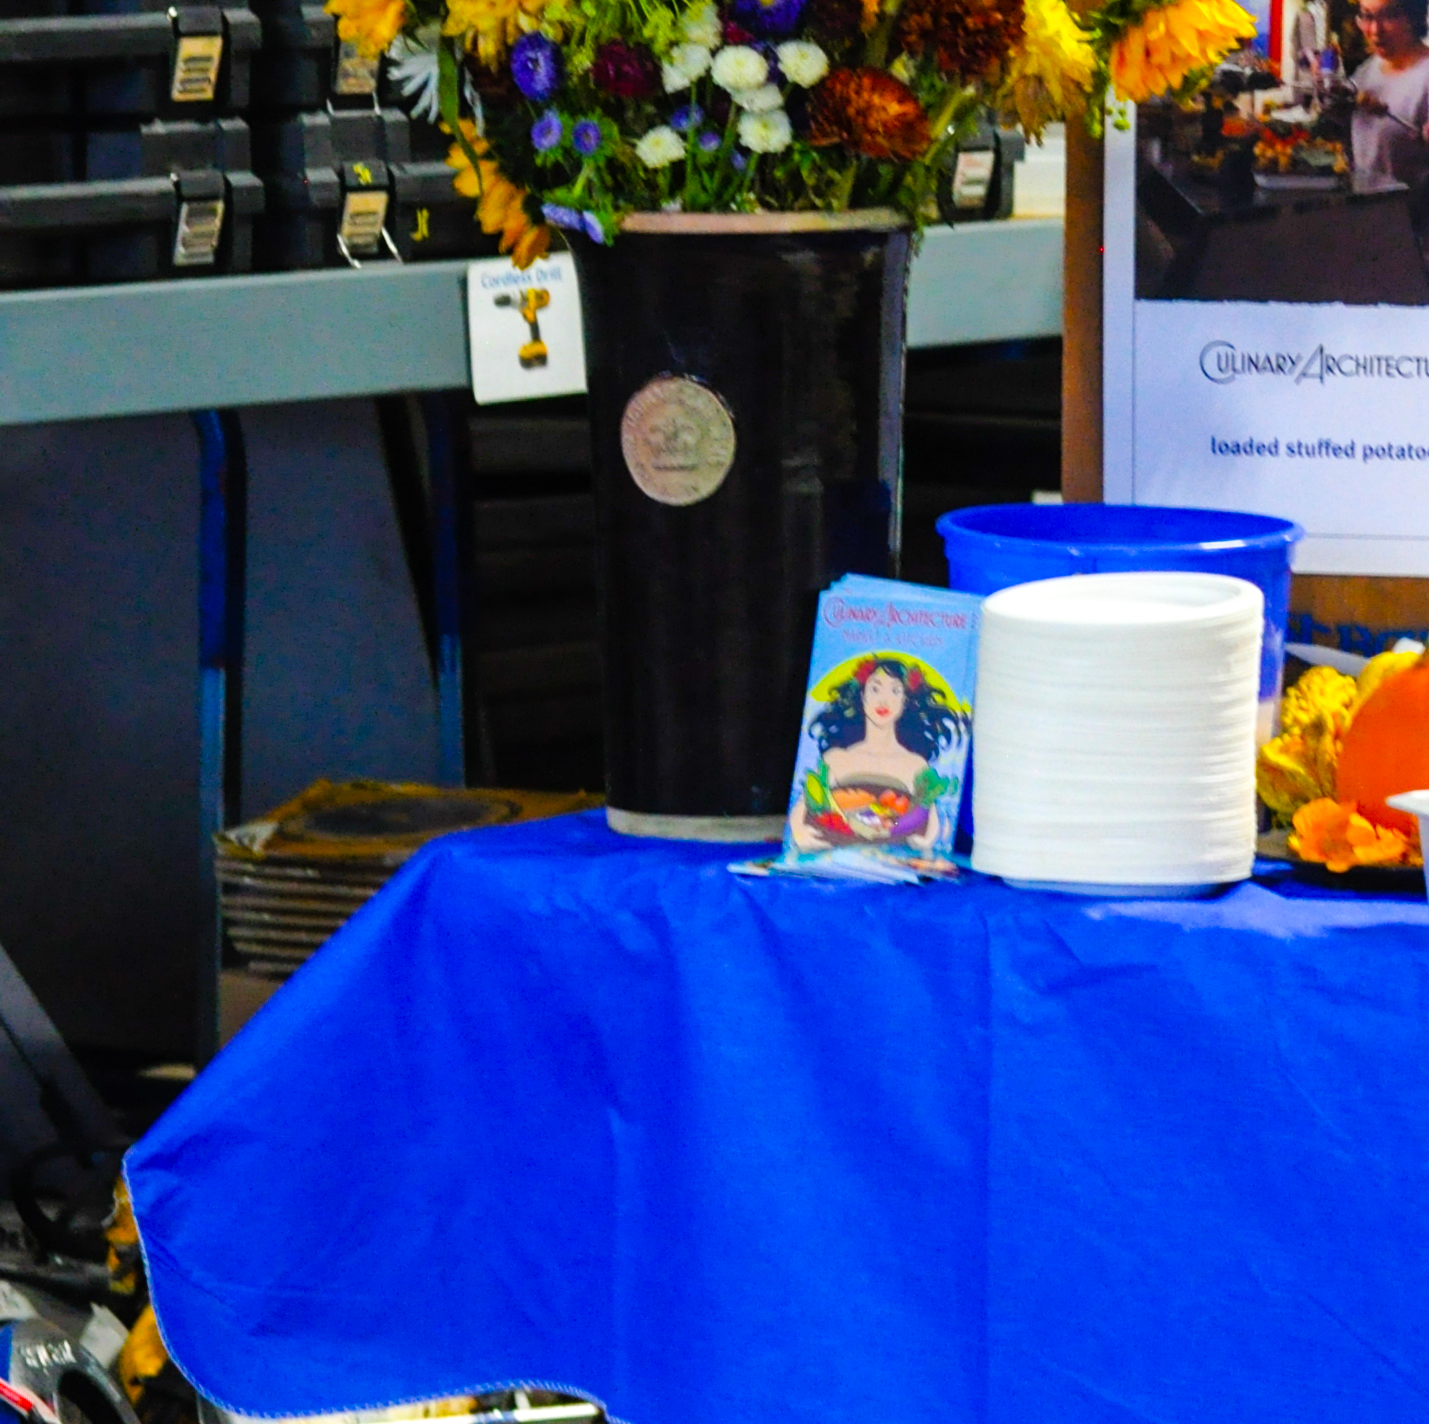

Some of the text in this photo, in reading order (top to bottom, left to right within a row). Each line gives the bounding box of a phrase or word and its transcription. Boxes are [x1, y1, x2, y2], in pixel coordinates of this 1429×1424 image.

[1199, 339, 1303, 385] CULINARY
[1210, 435, 1281, 458] loaded
[1286, 437, 1356, 461] stuffed
